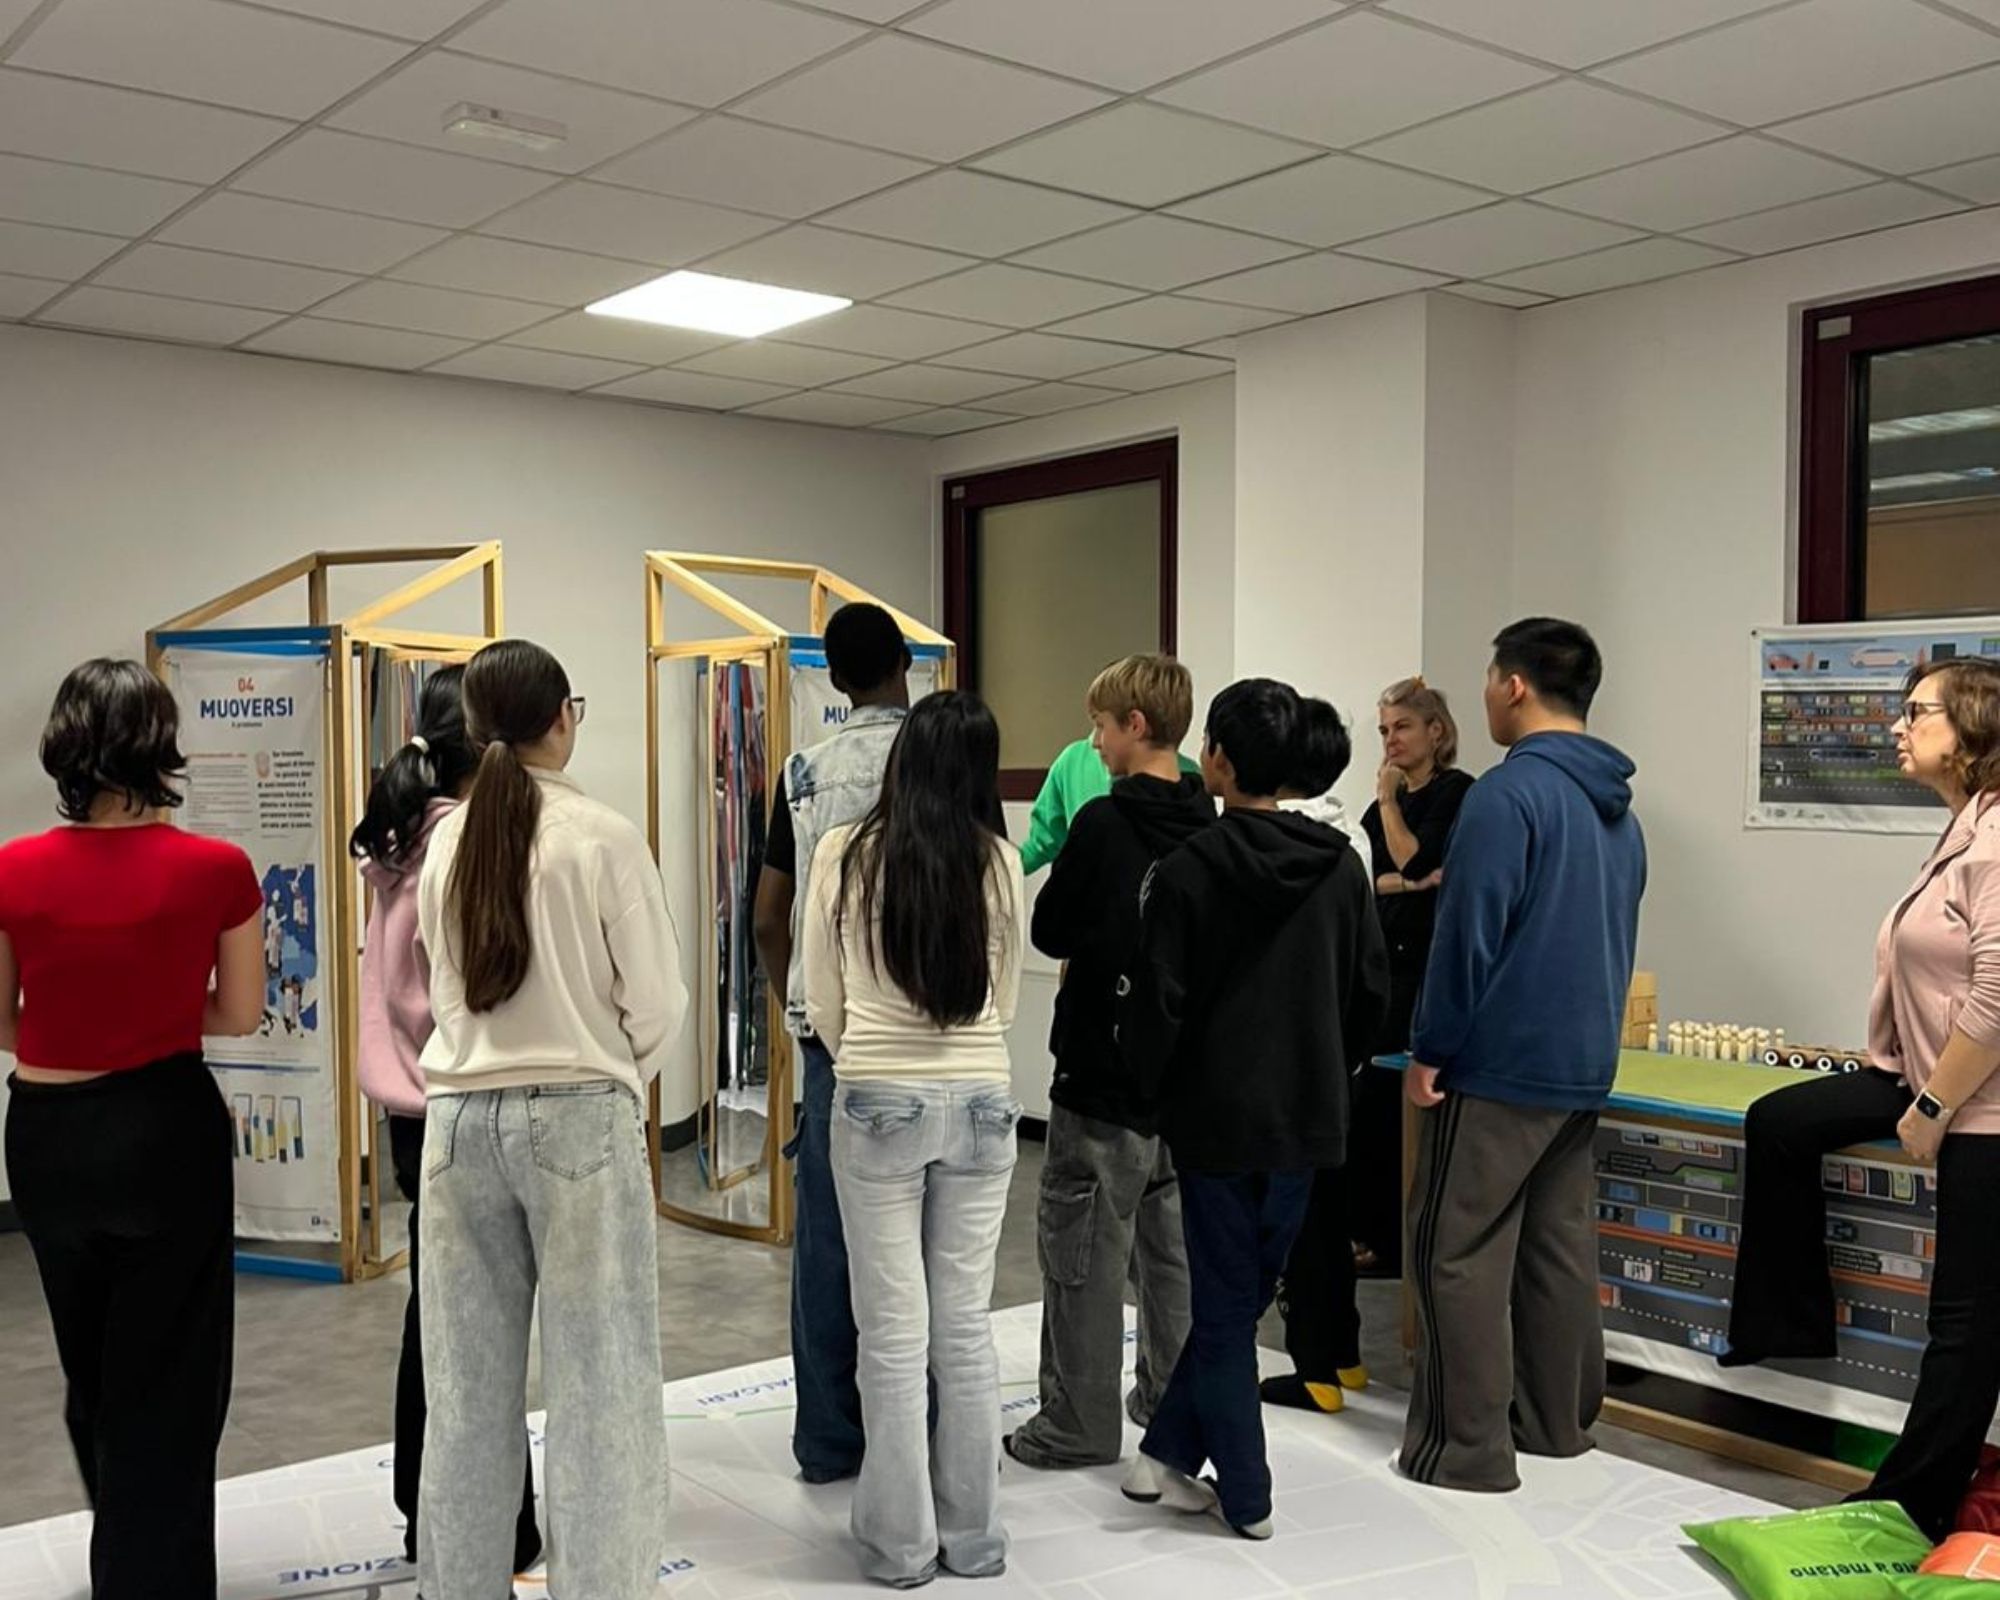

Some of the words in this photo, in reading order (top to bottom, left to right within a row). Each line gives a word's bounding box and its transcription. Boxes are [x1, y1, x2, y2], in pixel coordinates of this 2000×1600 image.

[238, 677, 255, 693] 04
[200, 697, 294, 719] MUOVERSI
[823, 705, 849, 725] MU
[277, 1556, 404, 1584] ZIONE
[1789, 1561, 1872, 1578] metano
